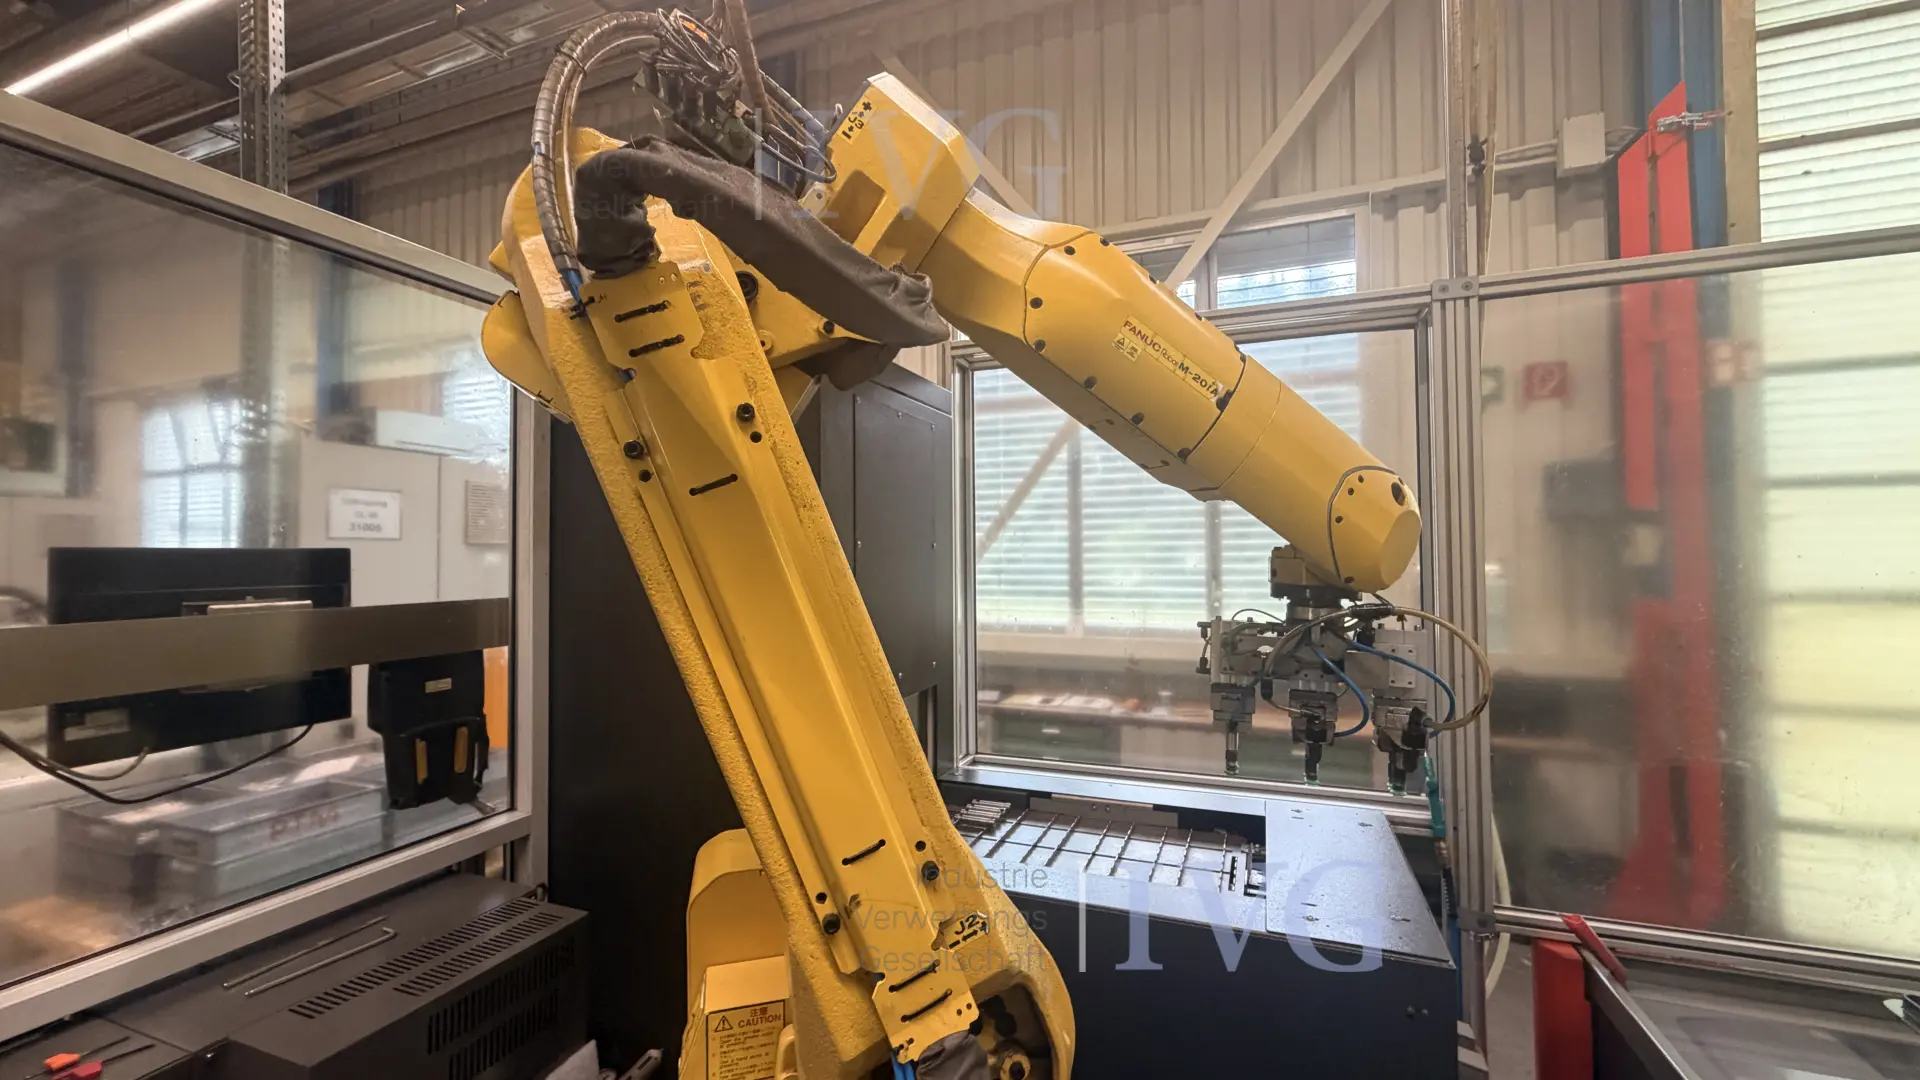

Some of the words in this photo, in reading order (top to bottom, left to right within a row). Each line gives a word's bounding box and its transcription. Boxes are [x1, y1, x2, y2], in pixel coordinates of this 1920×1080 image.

[1123, 320, 1162, 353] FANUC
[954, 914, 980, 935] J2
[737, 1013, 782, 1029] CAUTION
